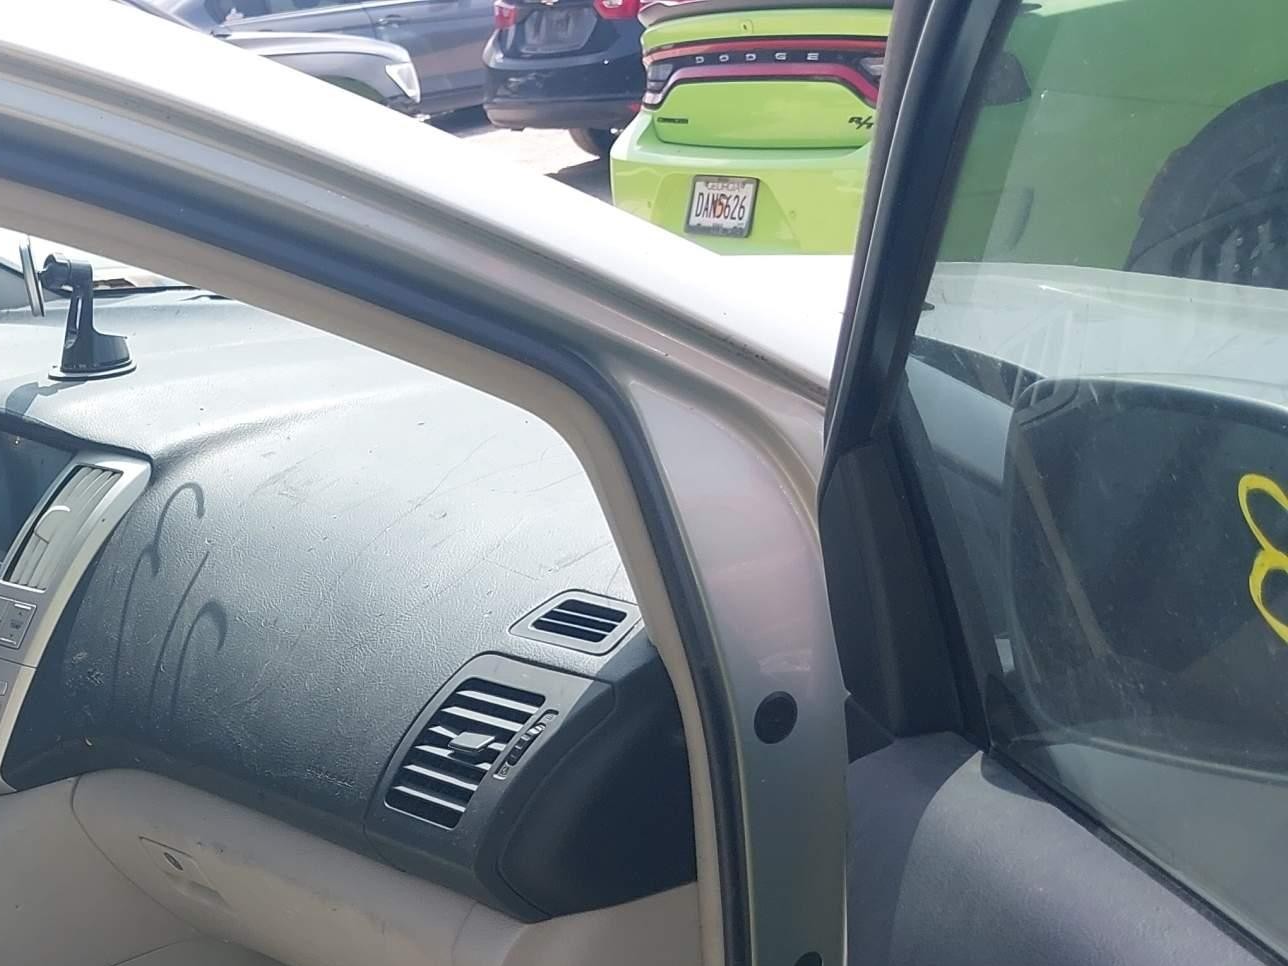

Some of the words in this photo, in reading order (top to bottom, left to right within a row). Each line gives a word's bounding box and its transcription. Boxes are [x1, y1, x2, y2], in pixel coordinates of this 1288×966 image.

[695, 52, 819, 64] DODGE
[848, 115, 874, 130] R/T
[695, 192, 747, 221] DAN5626
